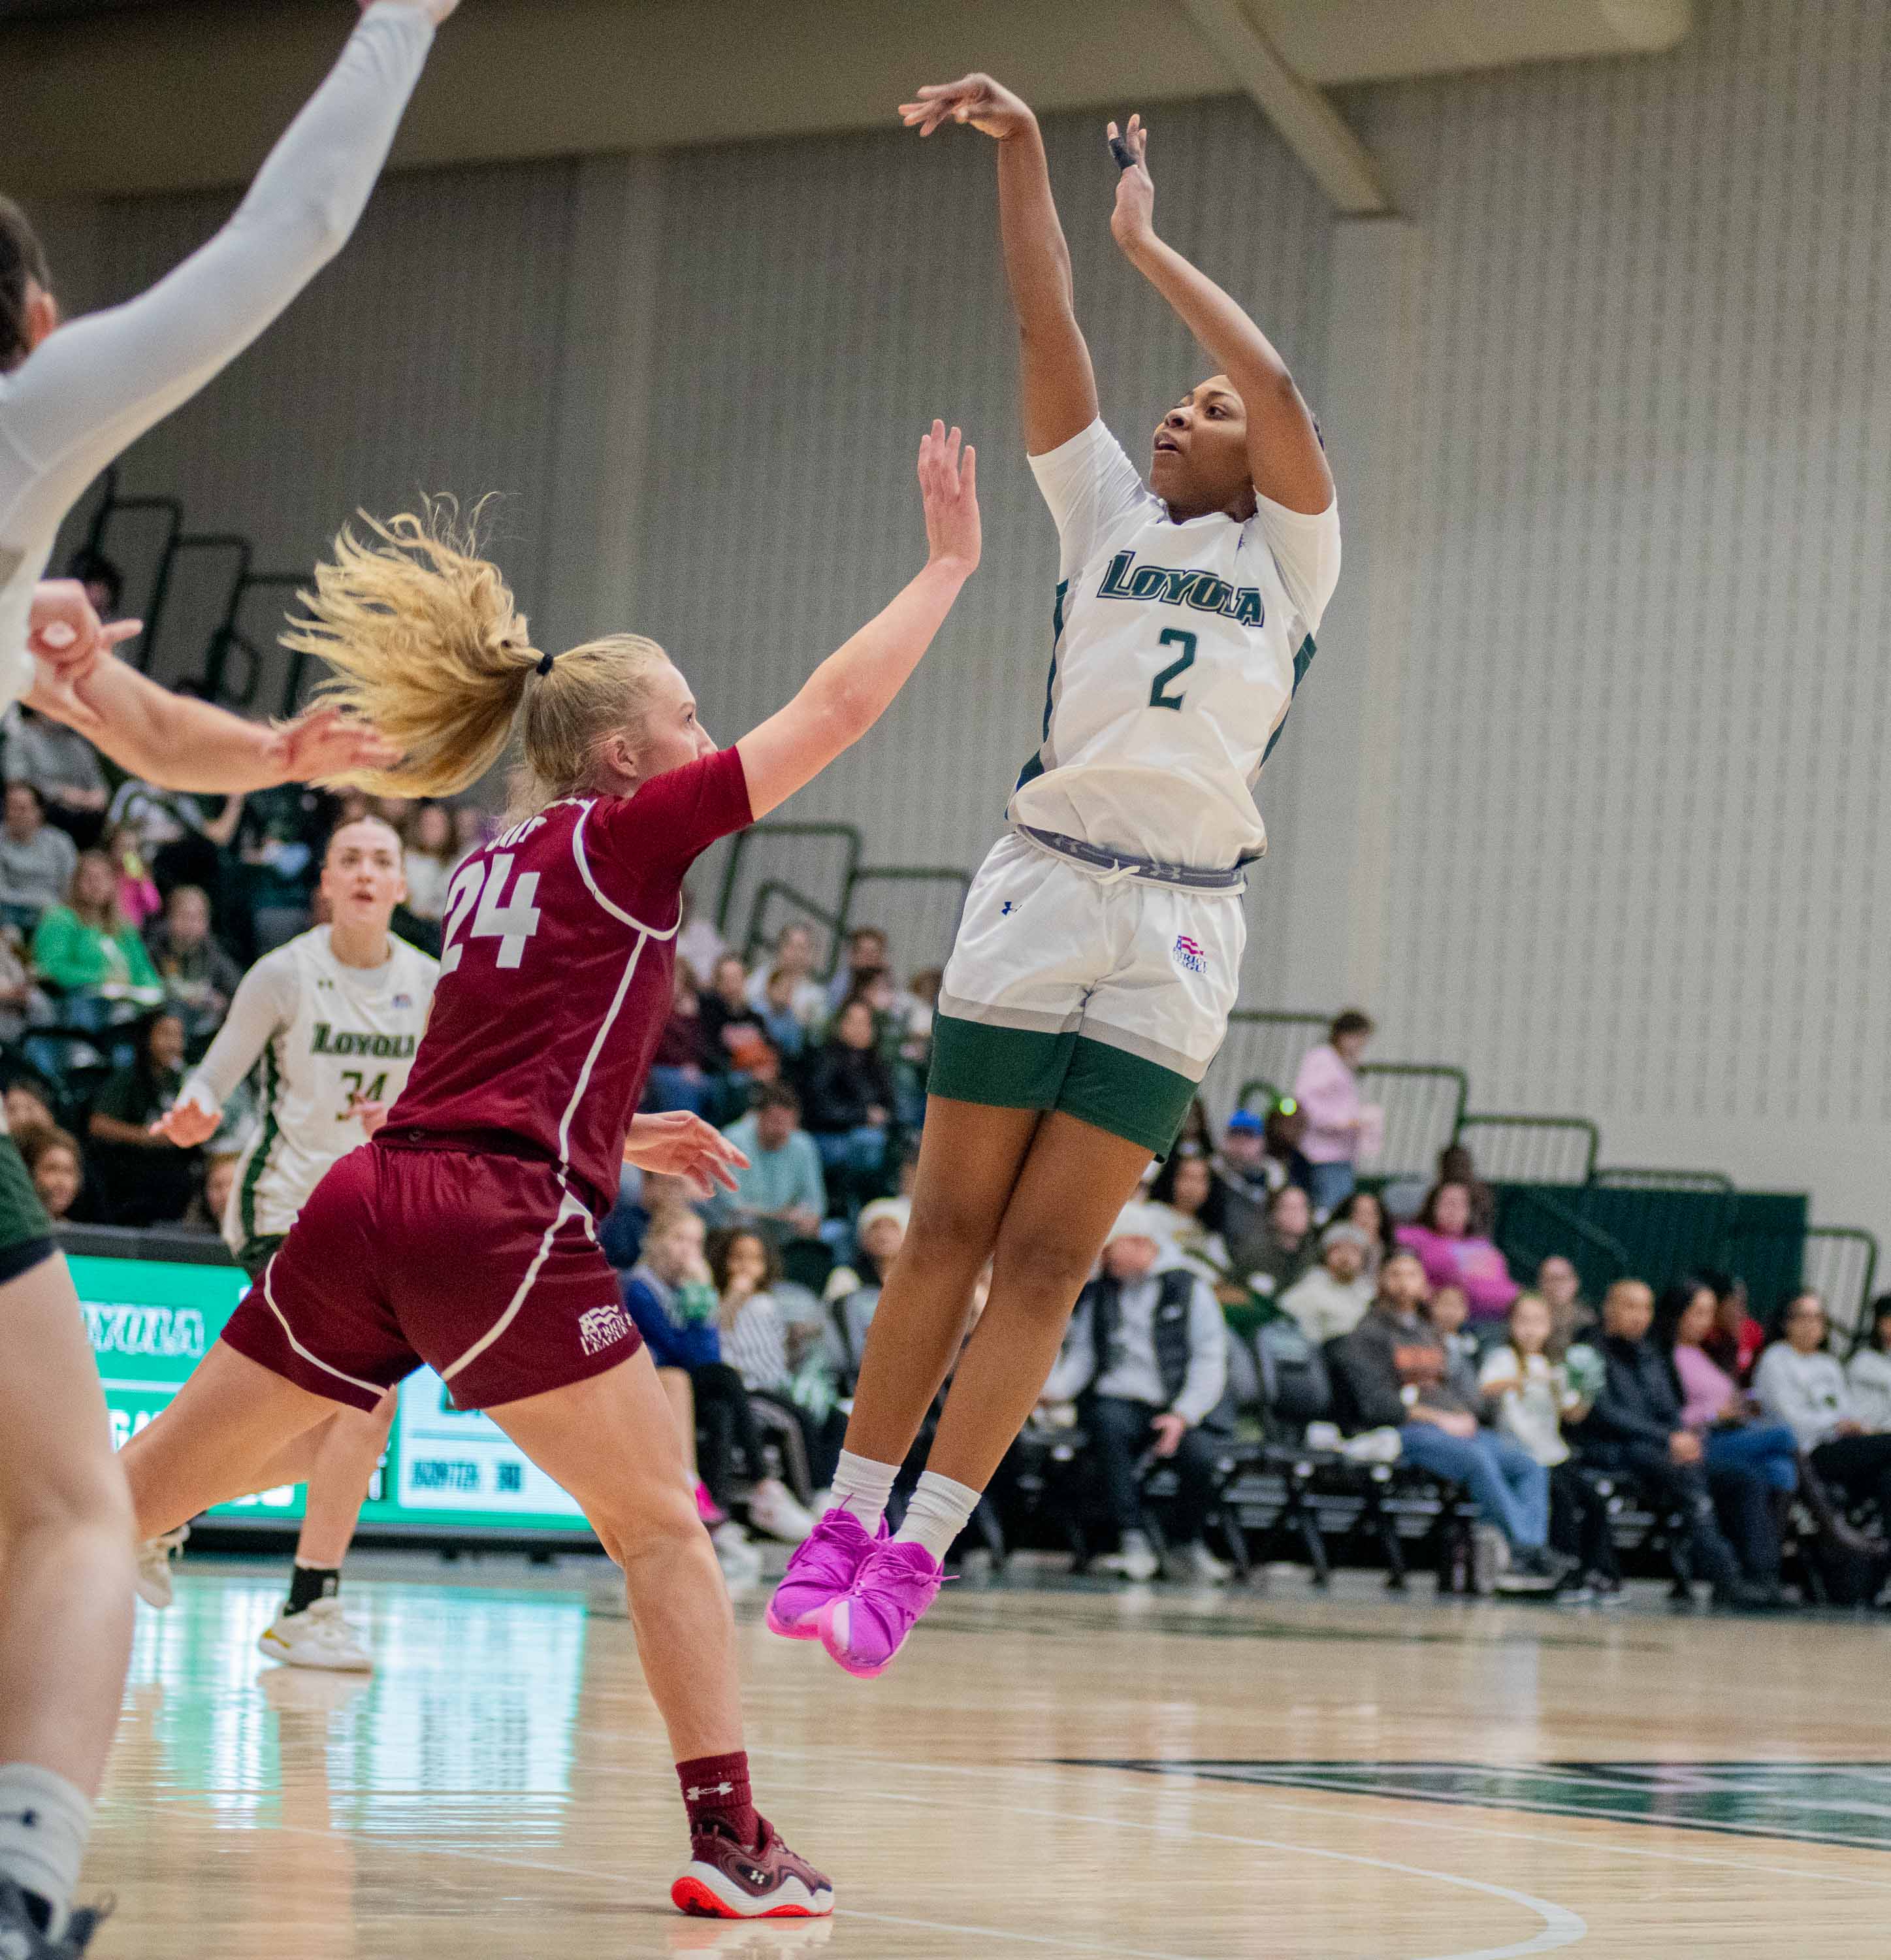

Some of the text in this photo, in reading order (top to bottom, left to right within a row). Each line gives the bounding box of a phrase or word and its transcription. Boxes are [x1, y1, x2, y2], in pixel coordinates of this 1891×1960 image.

[1096, 549, 1265, 628] LOYOLA
[1148, 627, 1197, 711] 2
[440, 853, 541, 978] 24
